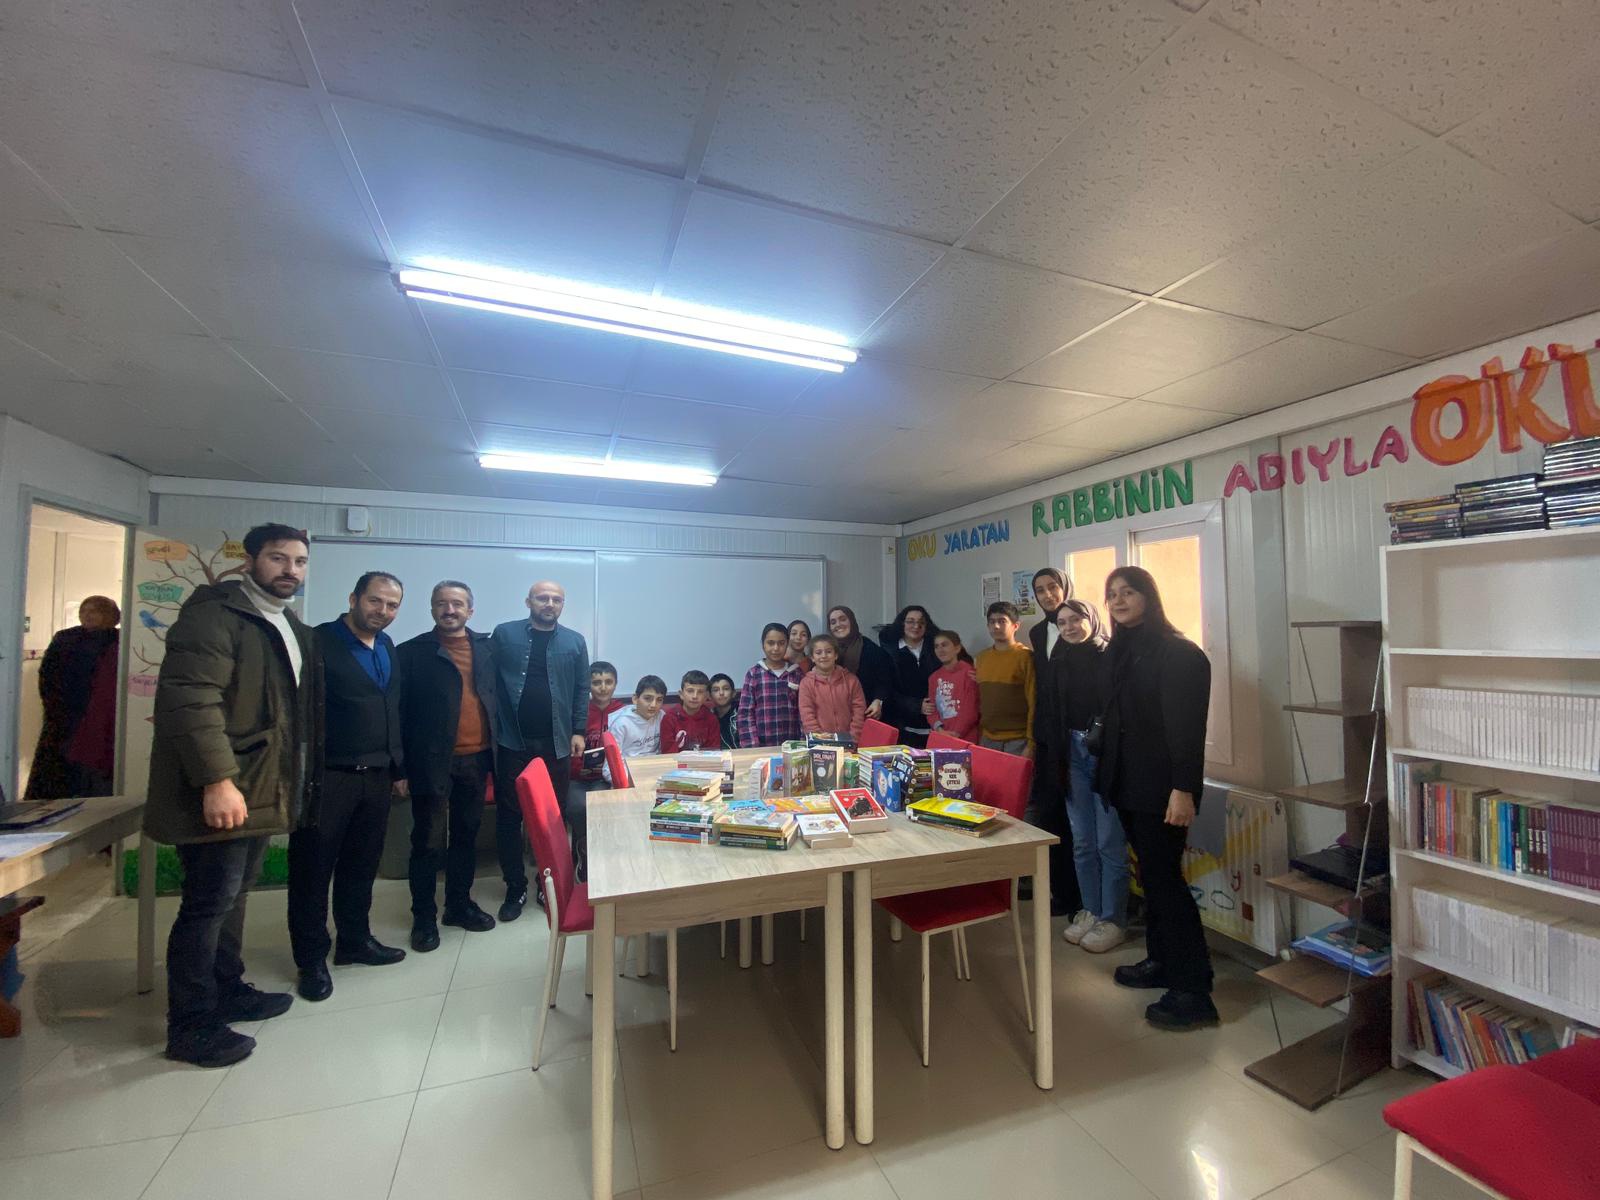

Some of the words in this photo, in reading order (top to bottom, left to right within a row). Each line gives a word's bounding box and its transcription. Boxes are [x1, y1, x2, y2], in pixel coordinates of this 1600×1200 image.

[908, 532, 937, 561] OKU
[944, 519, 1010, 555] YARATAN
[1224, 425, 1409, 498] ADIYLA
